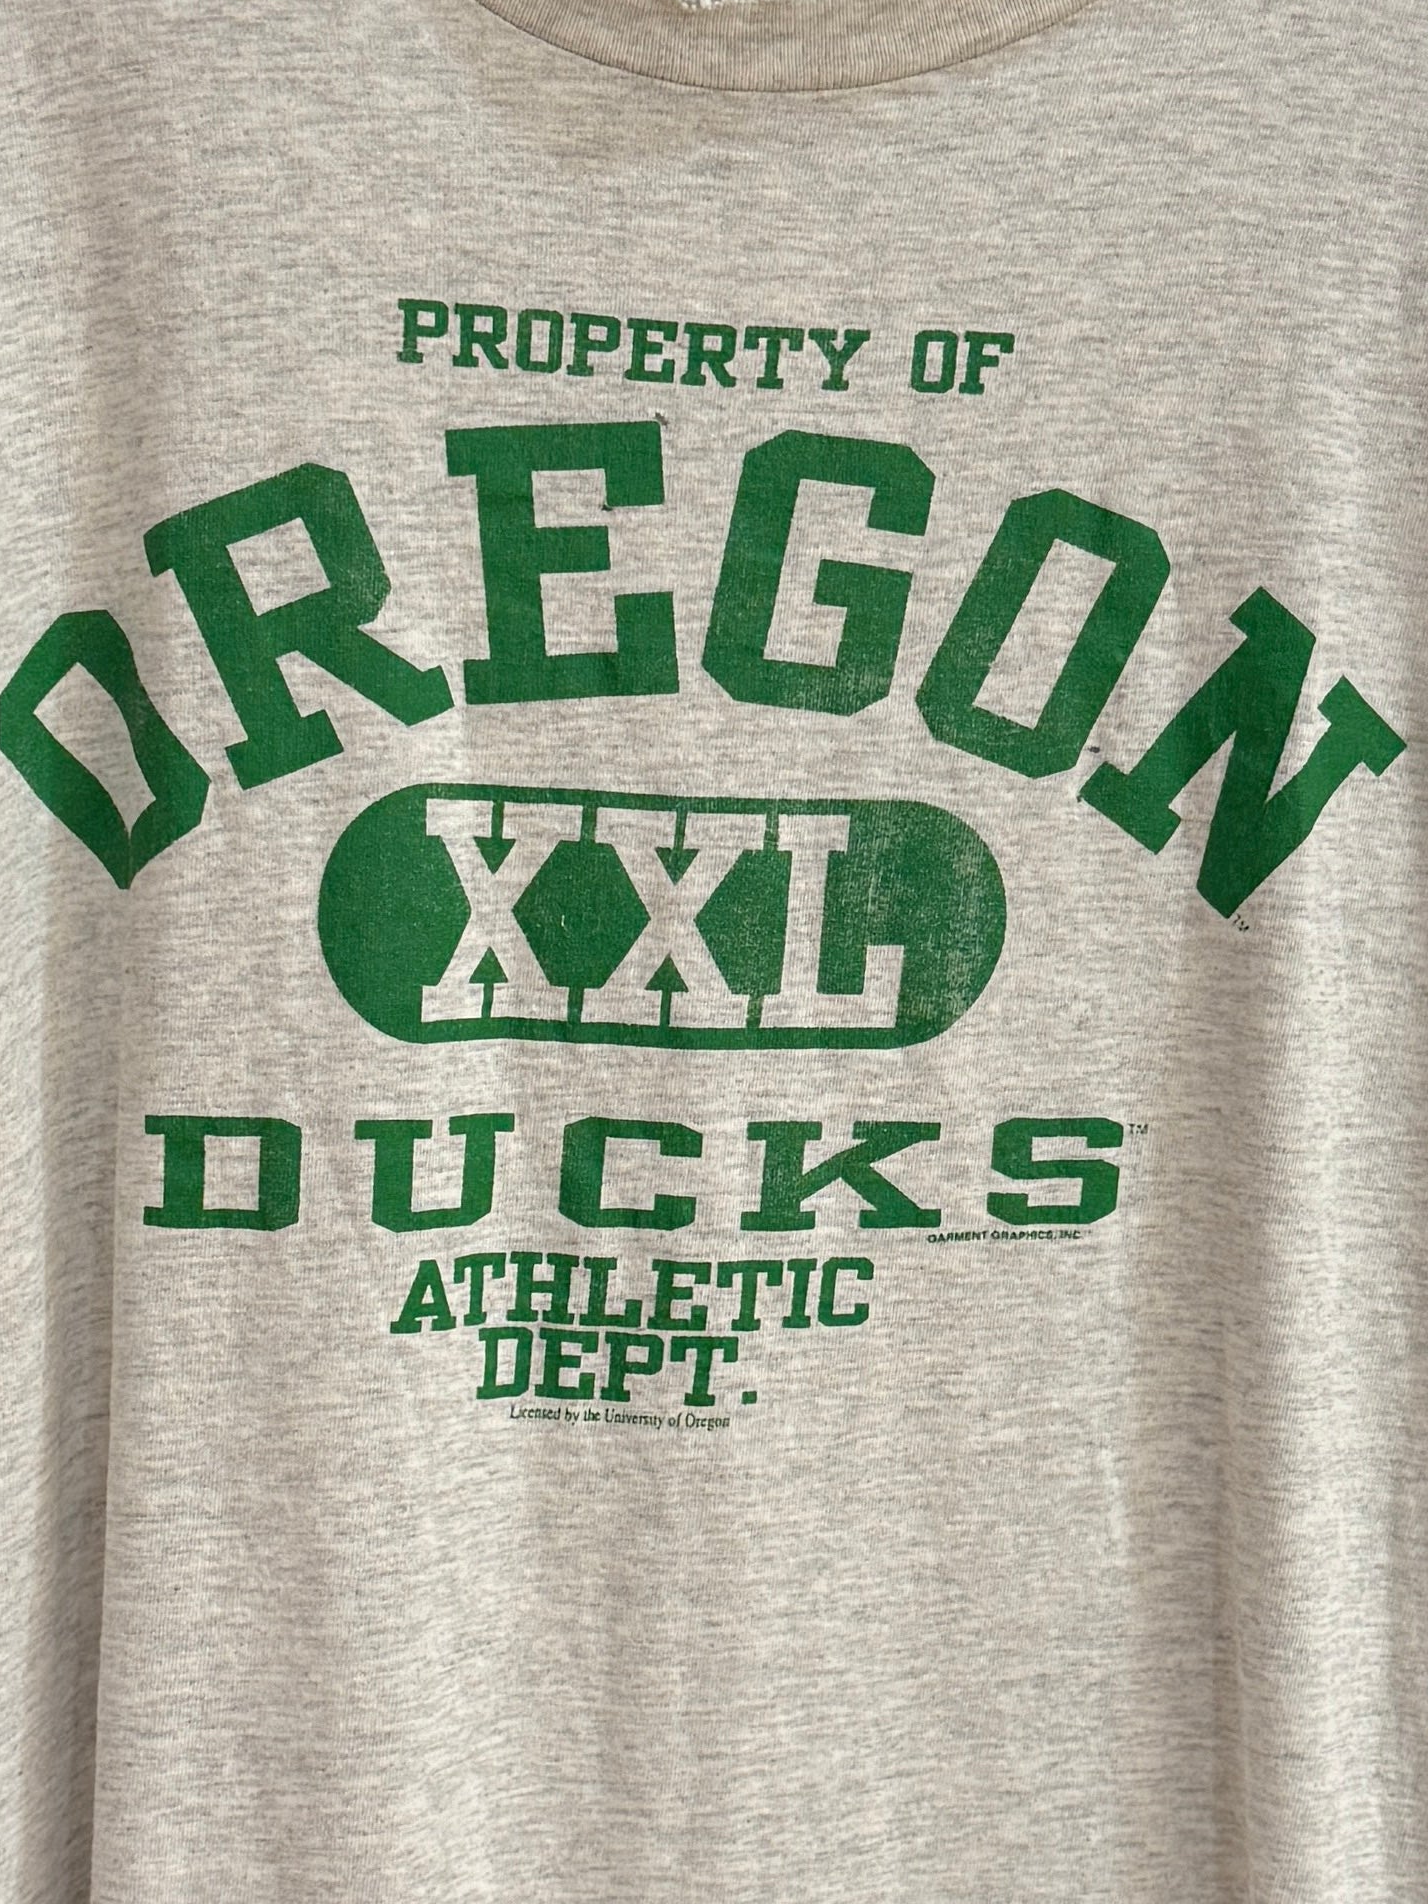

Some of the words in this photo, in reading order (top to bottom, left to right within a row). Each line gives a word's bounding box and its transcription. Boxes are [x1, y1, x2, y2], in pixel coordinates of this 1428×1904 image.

[397, 299, 871, 391] PROPERTY
[910, 329, 1015, 395] OF
[420, 797, 906, 1029] XXL
[142, 1113, 1125, 1233] DUCKS
[927, 1230, 988, 1244] GARMENT
[389, 1250, 876, 1335] ATHLETIC
[475, 1325, 759, 1408] DEPT.
[509, 1405, 561, 1421] Licensed
[564, 1408, 580, 1426] by
[583, 1408, 601, 1423] the
[604, 1408, 665, 1430] University
[668, 1412, 683, 1424] of
[684, 1412, 731, 1432] Oregon
